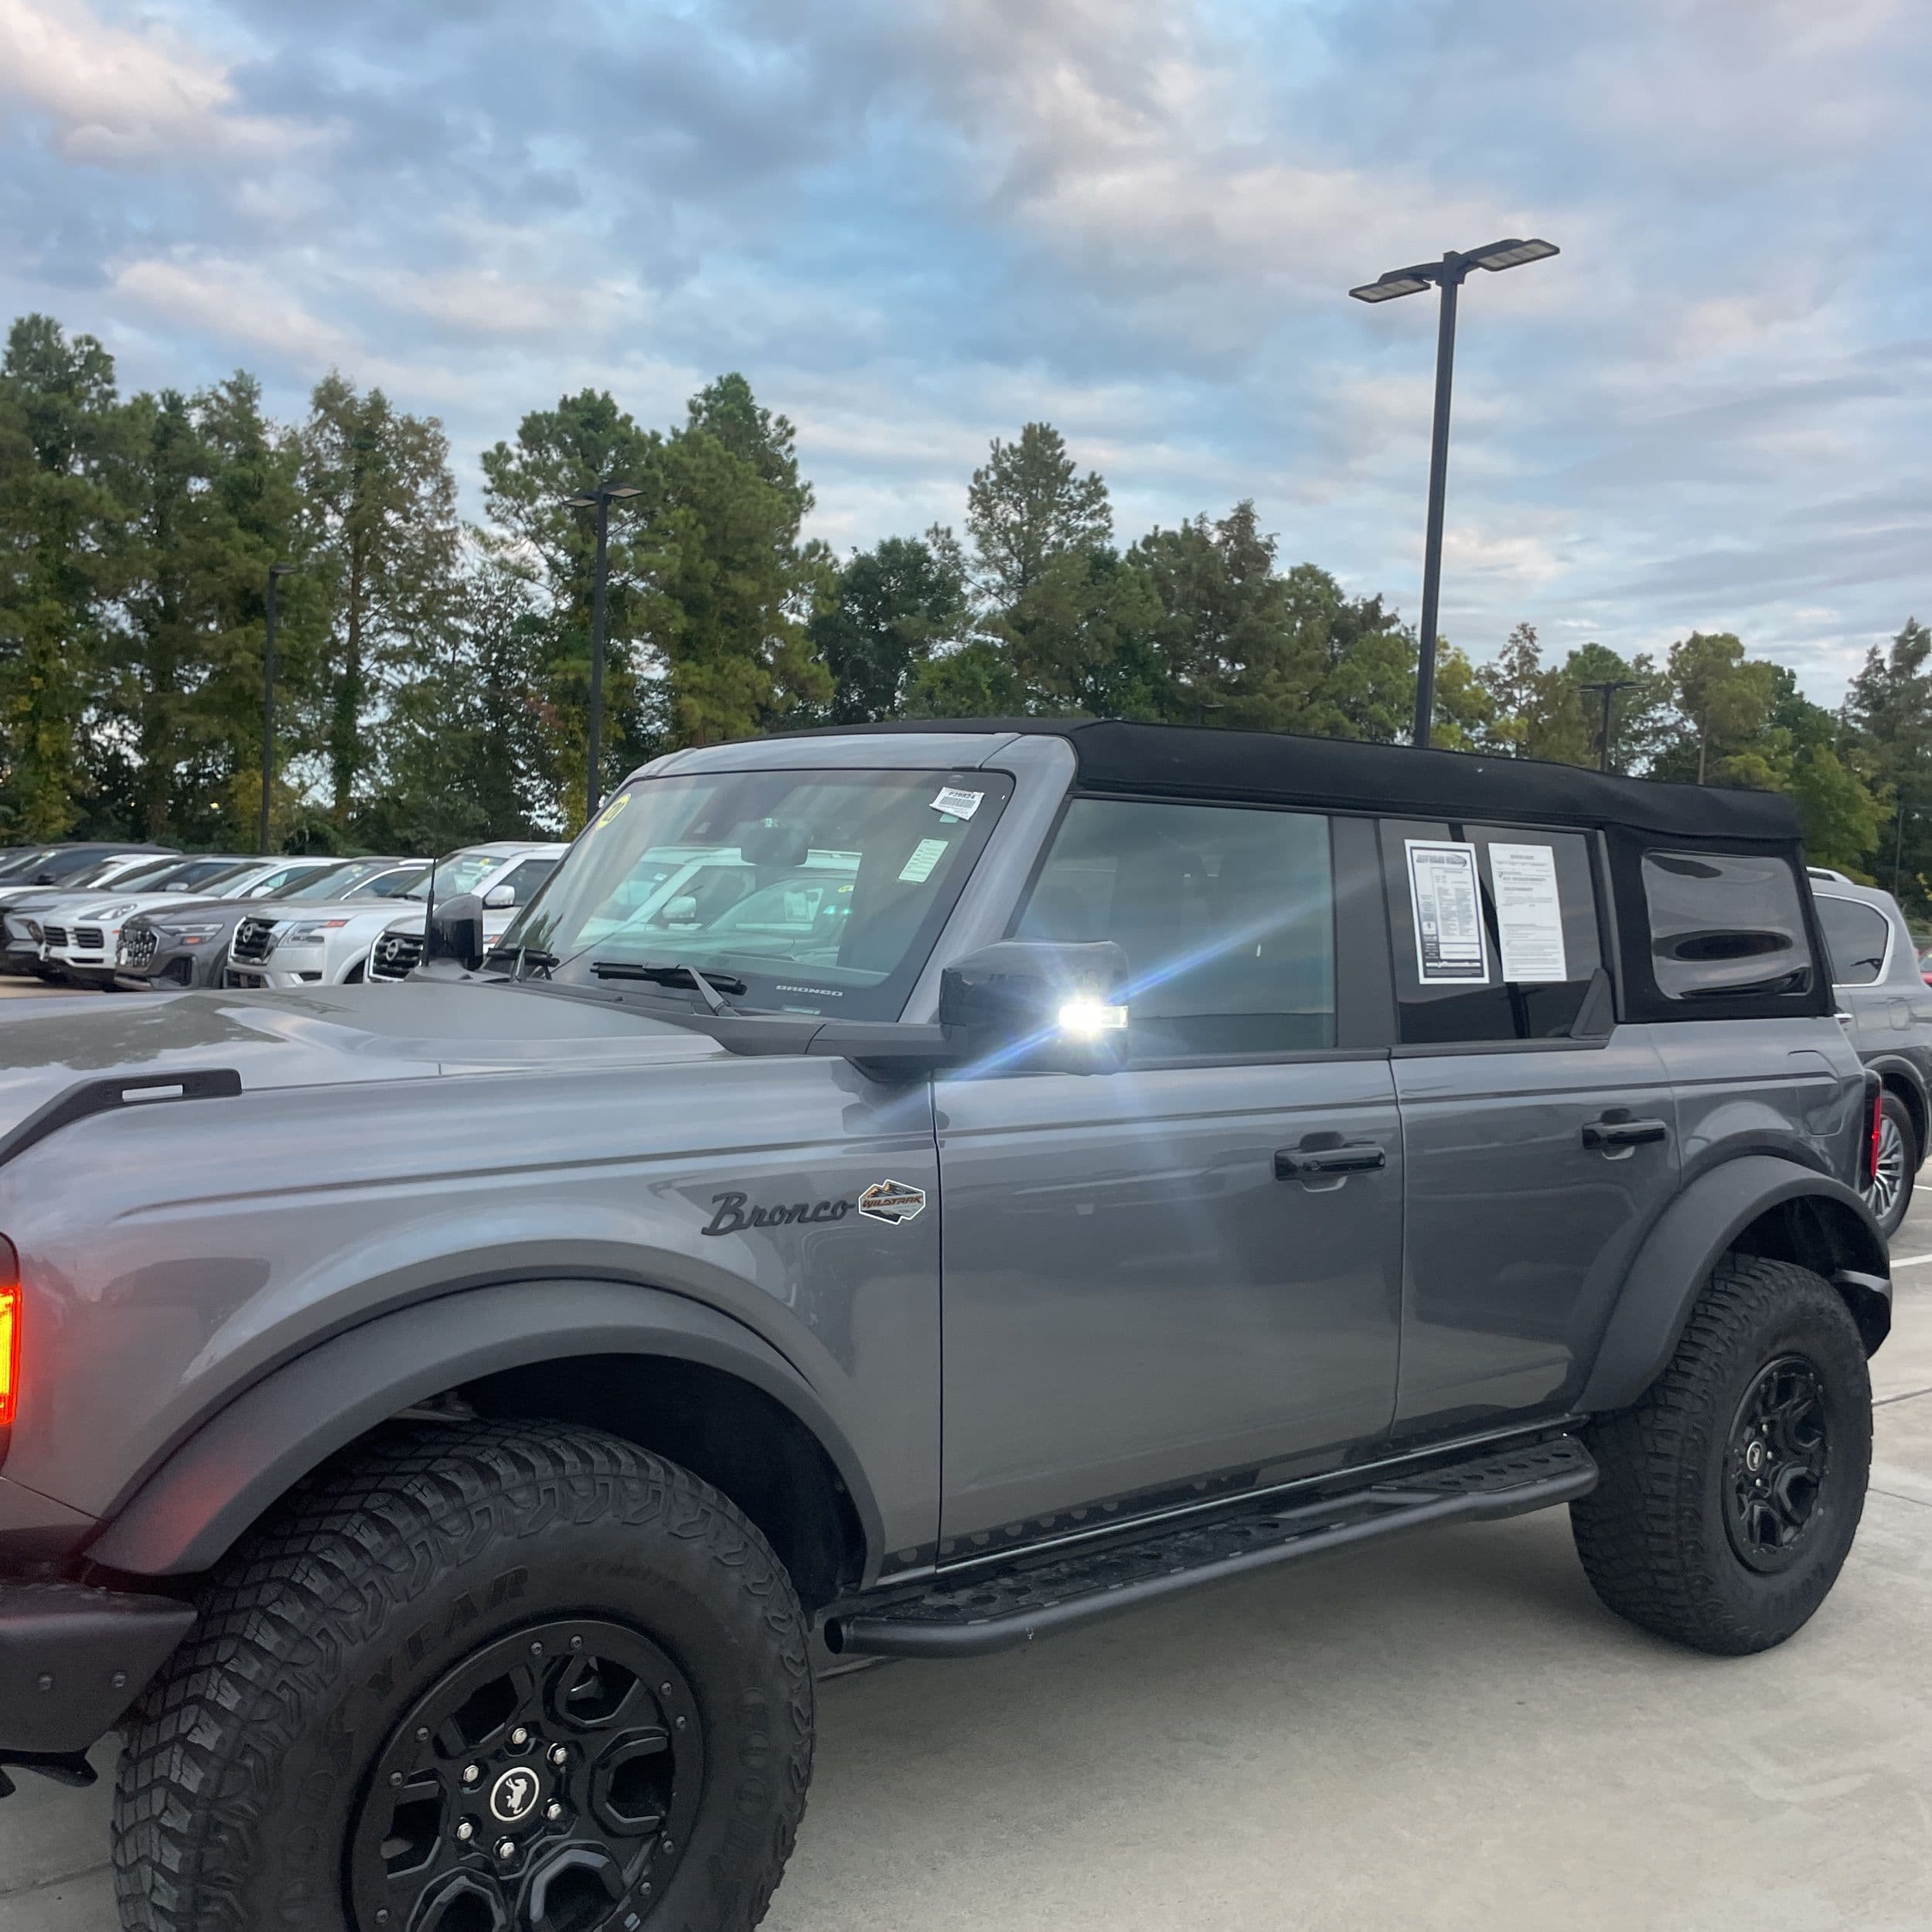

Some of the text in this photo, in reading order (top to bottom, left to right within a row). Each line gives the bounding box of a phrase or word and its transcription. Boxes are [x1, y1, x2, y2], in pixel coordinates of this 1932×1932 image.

[775, 985, 843, 997] BRONCO
[862, 1195, 923, 1208] WILDTRAK
[700, 1191, 856, 1236] Bronco
